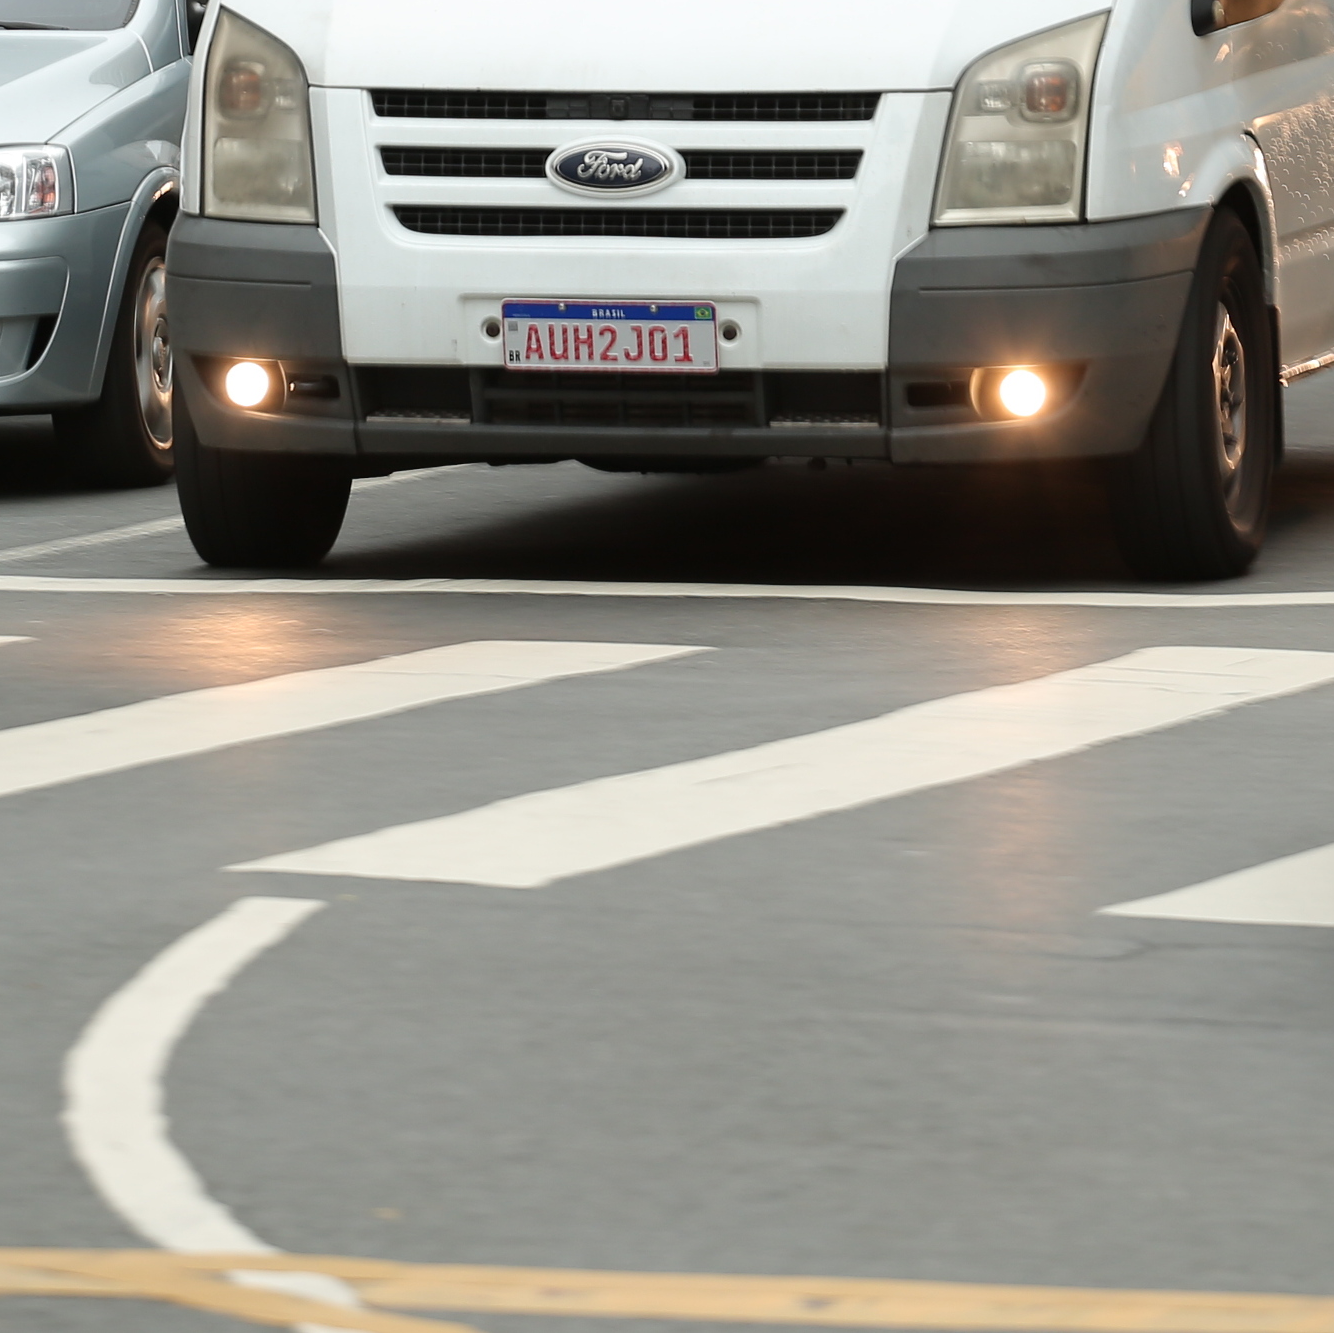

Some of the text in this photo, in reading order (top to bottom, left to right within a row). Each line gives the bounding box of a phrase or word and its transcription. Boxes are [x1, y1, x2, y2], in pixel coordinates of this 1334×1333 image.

[577, 150, 644, 181] Ford
[591, 308, 626, 319] BRASIL
[525, 322, 694, 363] AUH2J01
[509, 349, 521, 363] BR
